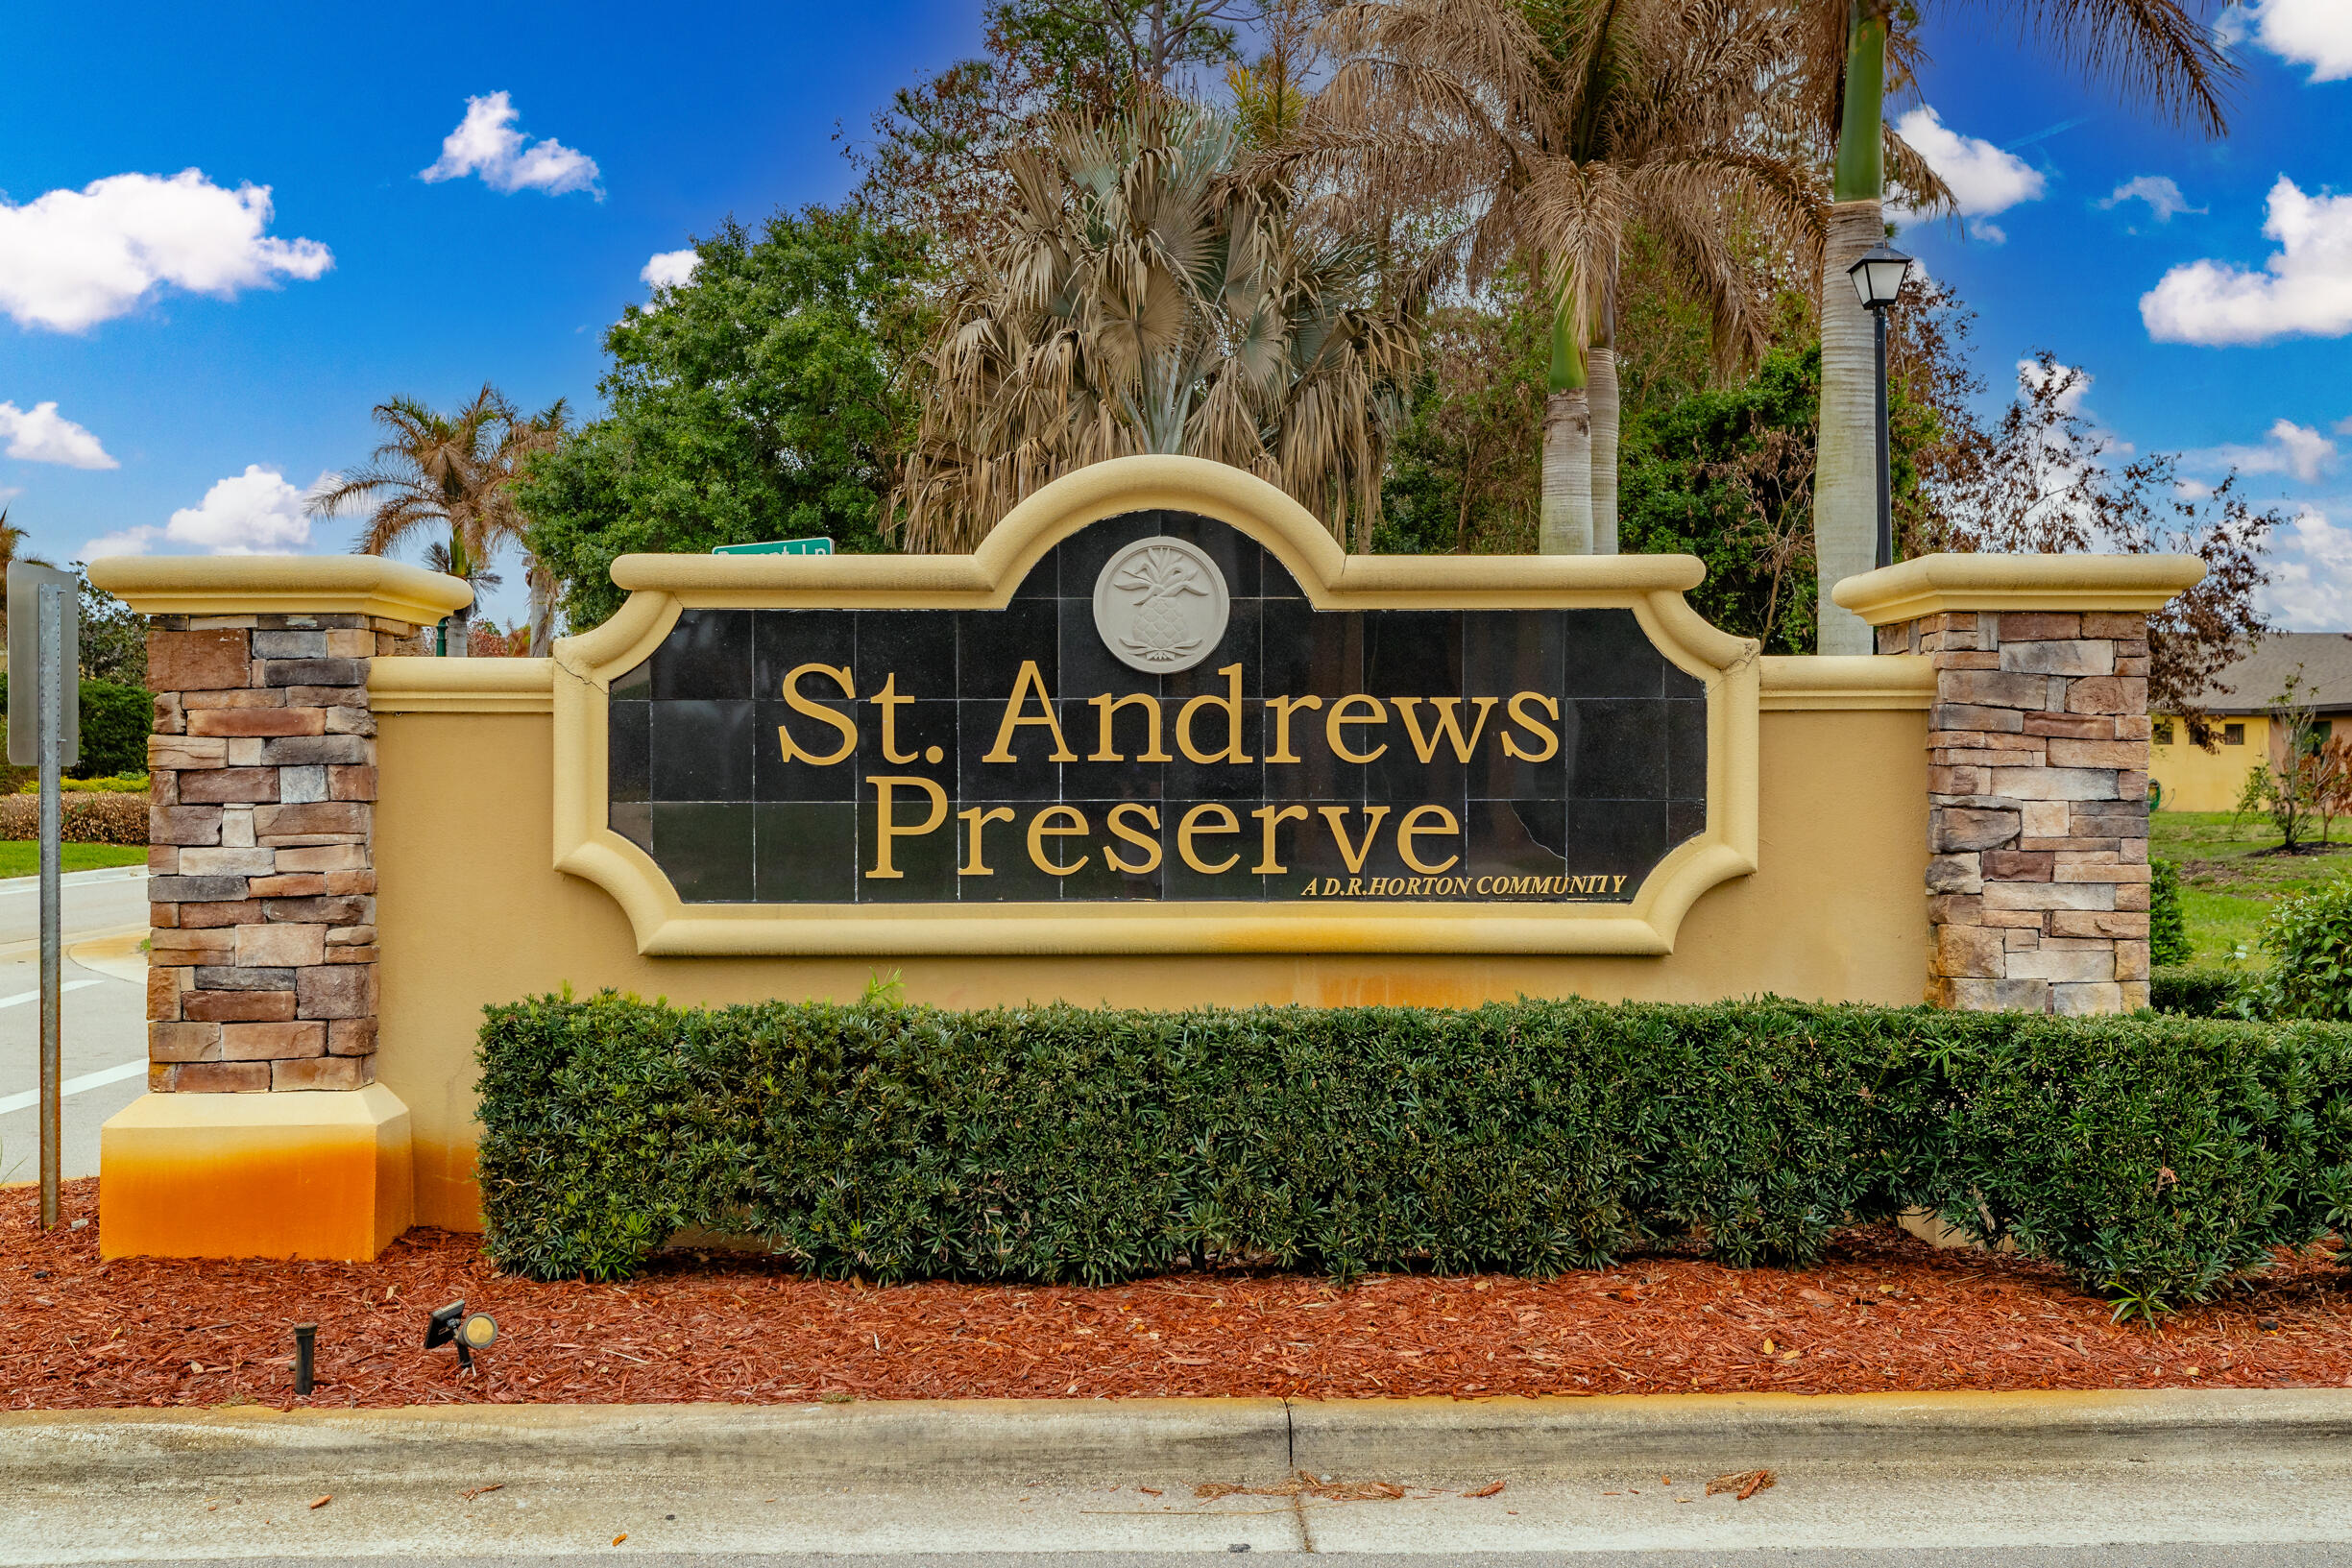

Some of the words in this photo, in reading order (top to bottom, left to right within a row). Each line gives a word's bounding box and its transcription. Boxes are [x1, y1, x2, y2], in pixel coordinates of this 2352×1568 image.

[777, 662, 944, 766] St.
[982, 660, 1560, 766] Andrews
[864, 775, 1460, 879] Preserve
[1300, 877, 1318, 896] A
[1475, 875, 1627, 895] COMMUNITY
